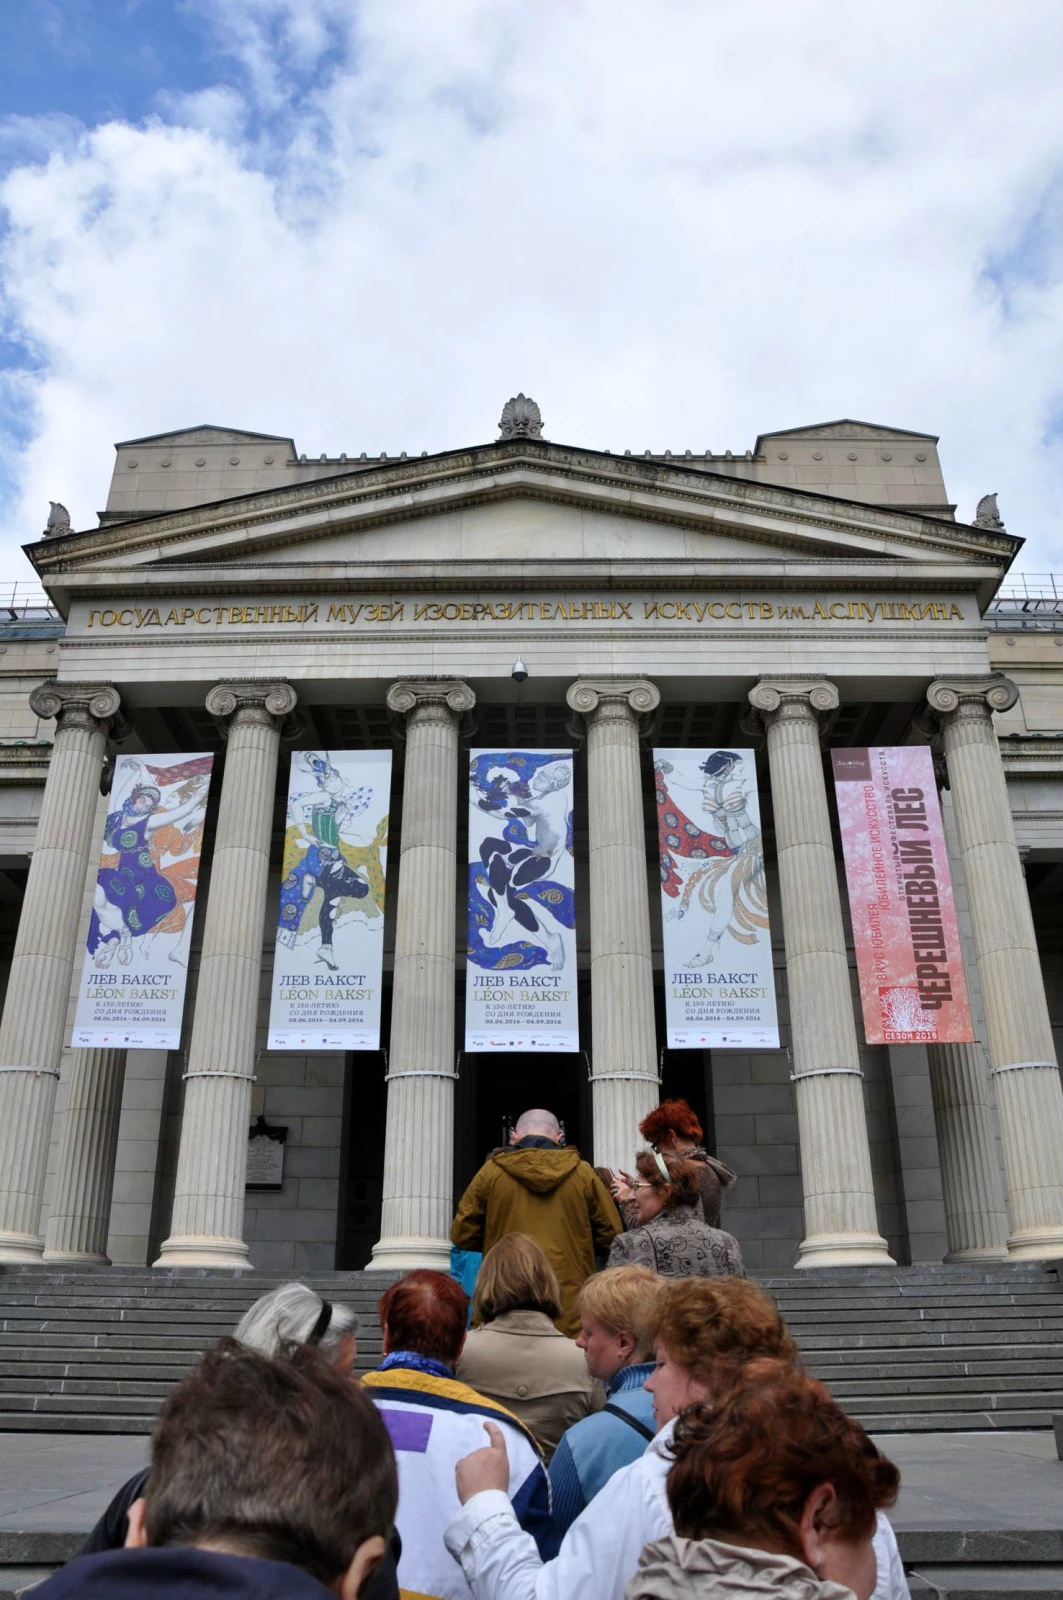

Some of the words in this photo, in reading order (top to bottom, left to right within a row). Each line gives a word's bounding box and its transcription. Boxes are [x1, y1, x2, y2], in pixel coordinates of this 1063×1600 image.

[87, 602, 320, 628] ГОСУДАРСТВЕННЫЙ
[326, 601, 404, 624] МУЗЕЙ
[413, 601, 633, 623] ИЗОБРАЗИТЕЛЬНЫХ
[644, 601, 775, 622] ИСКУССТВ
[878, 751, 891, 791] ИСКУССТВ
[863, 785, 881, 844] ИСКУССТВО
[890, 787, 930, 832] ЛЕС
[871, 846, 890, 911] ЮБИЛЕЙНОЕ
[867, 903, 884, 949] ЮБИЛЕЯ
[892, 840, 953, 1010] ЧЕРЕШНЕВЫЙ
[873, 952, 888, 981] ВКУС
[87, 974, 118, 985] ЛЕВ
[121, 974, 172, 986] БАКСТ
[279, 975, 310, 986] ЛЕВ
[315, 975, 367, 986] БАКСТ
[473, 976, 505, 987] ЛЕВ
[509, 976, 562, 987] БАКСТ
[671, 973, 703, 984] ЛЕВ
[707, 973, 758, 984] БАКСТ
[86, 985, 125, 999] LÉON
[129, 988, 179, 1000] BAKST
[279, 986, 319, 1000] LÉON
[324, 989, 375, 1000] BAKST
[473, 987, 515, 1002] LÉON
[520, 990, 571, 1002] BAKST
[672, 984, 713, 999] LÉON
[718, 987, 769, 999] BAKST
[885, 1032, 913, 1040] СЕЗОН
